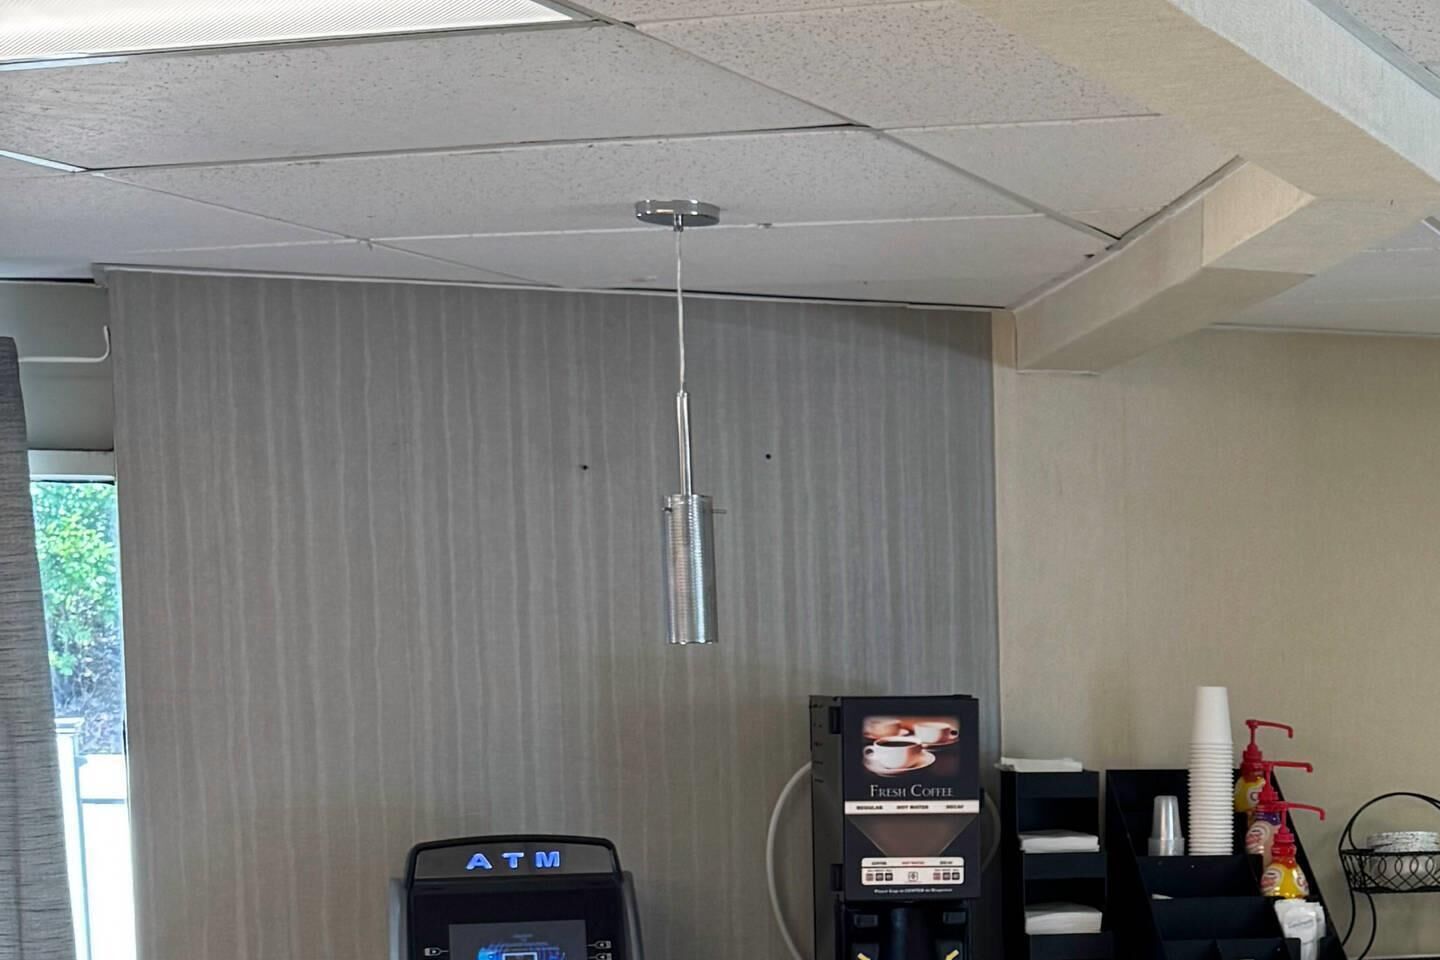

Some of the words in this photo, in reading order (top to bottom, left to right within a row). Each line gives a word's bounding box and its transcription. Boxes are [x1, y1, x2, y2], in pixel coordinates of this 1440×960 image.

[870, 784, 907, 798] FRESH
[910, 783, 953, 798] COFFEE
[466, 851, 561, 870] ATM
